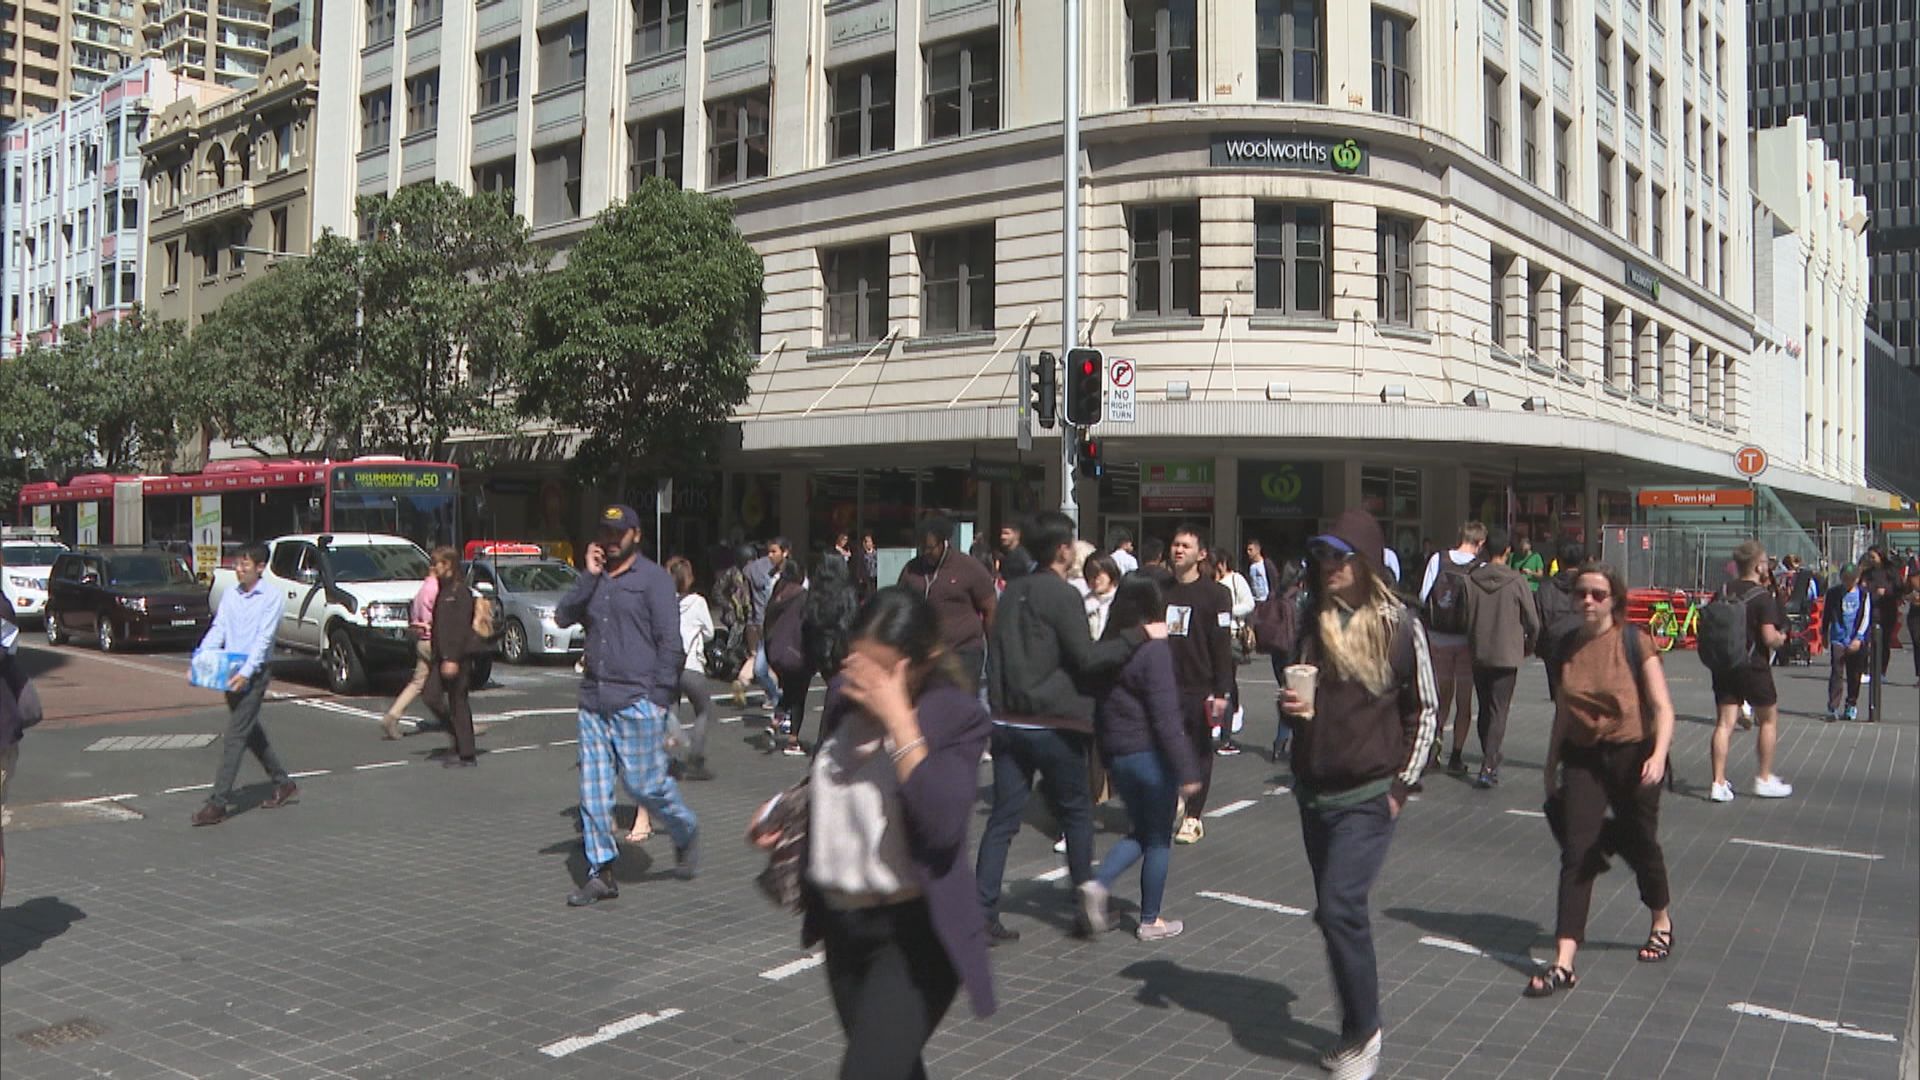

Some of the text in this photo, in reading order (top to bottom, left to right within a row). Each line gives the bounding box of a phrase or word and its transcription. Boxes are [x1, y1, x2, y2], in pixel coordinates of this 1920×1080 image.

[1226, 138, 1327, 161] Woolworths
[1114, 390, 1129, 400] NO
[1110, 402, 1132, 410] RIGHT
[1111, 410, 1131, 419] TURN
[1743, 453, 1758, 471] T
[416, 473, 438, 488] M50
[1673, 493, 1716, 503] Town Hall
